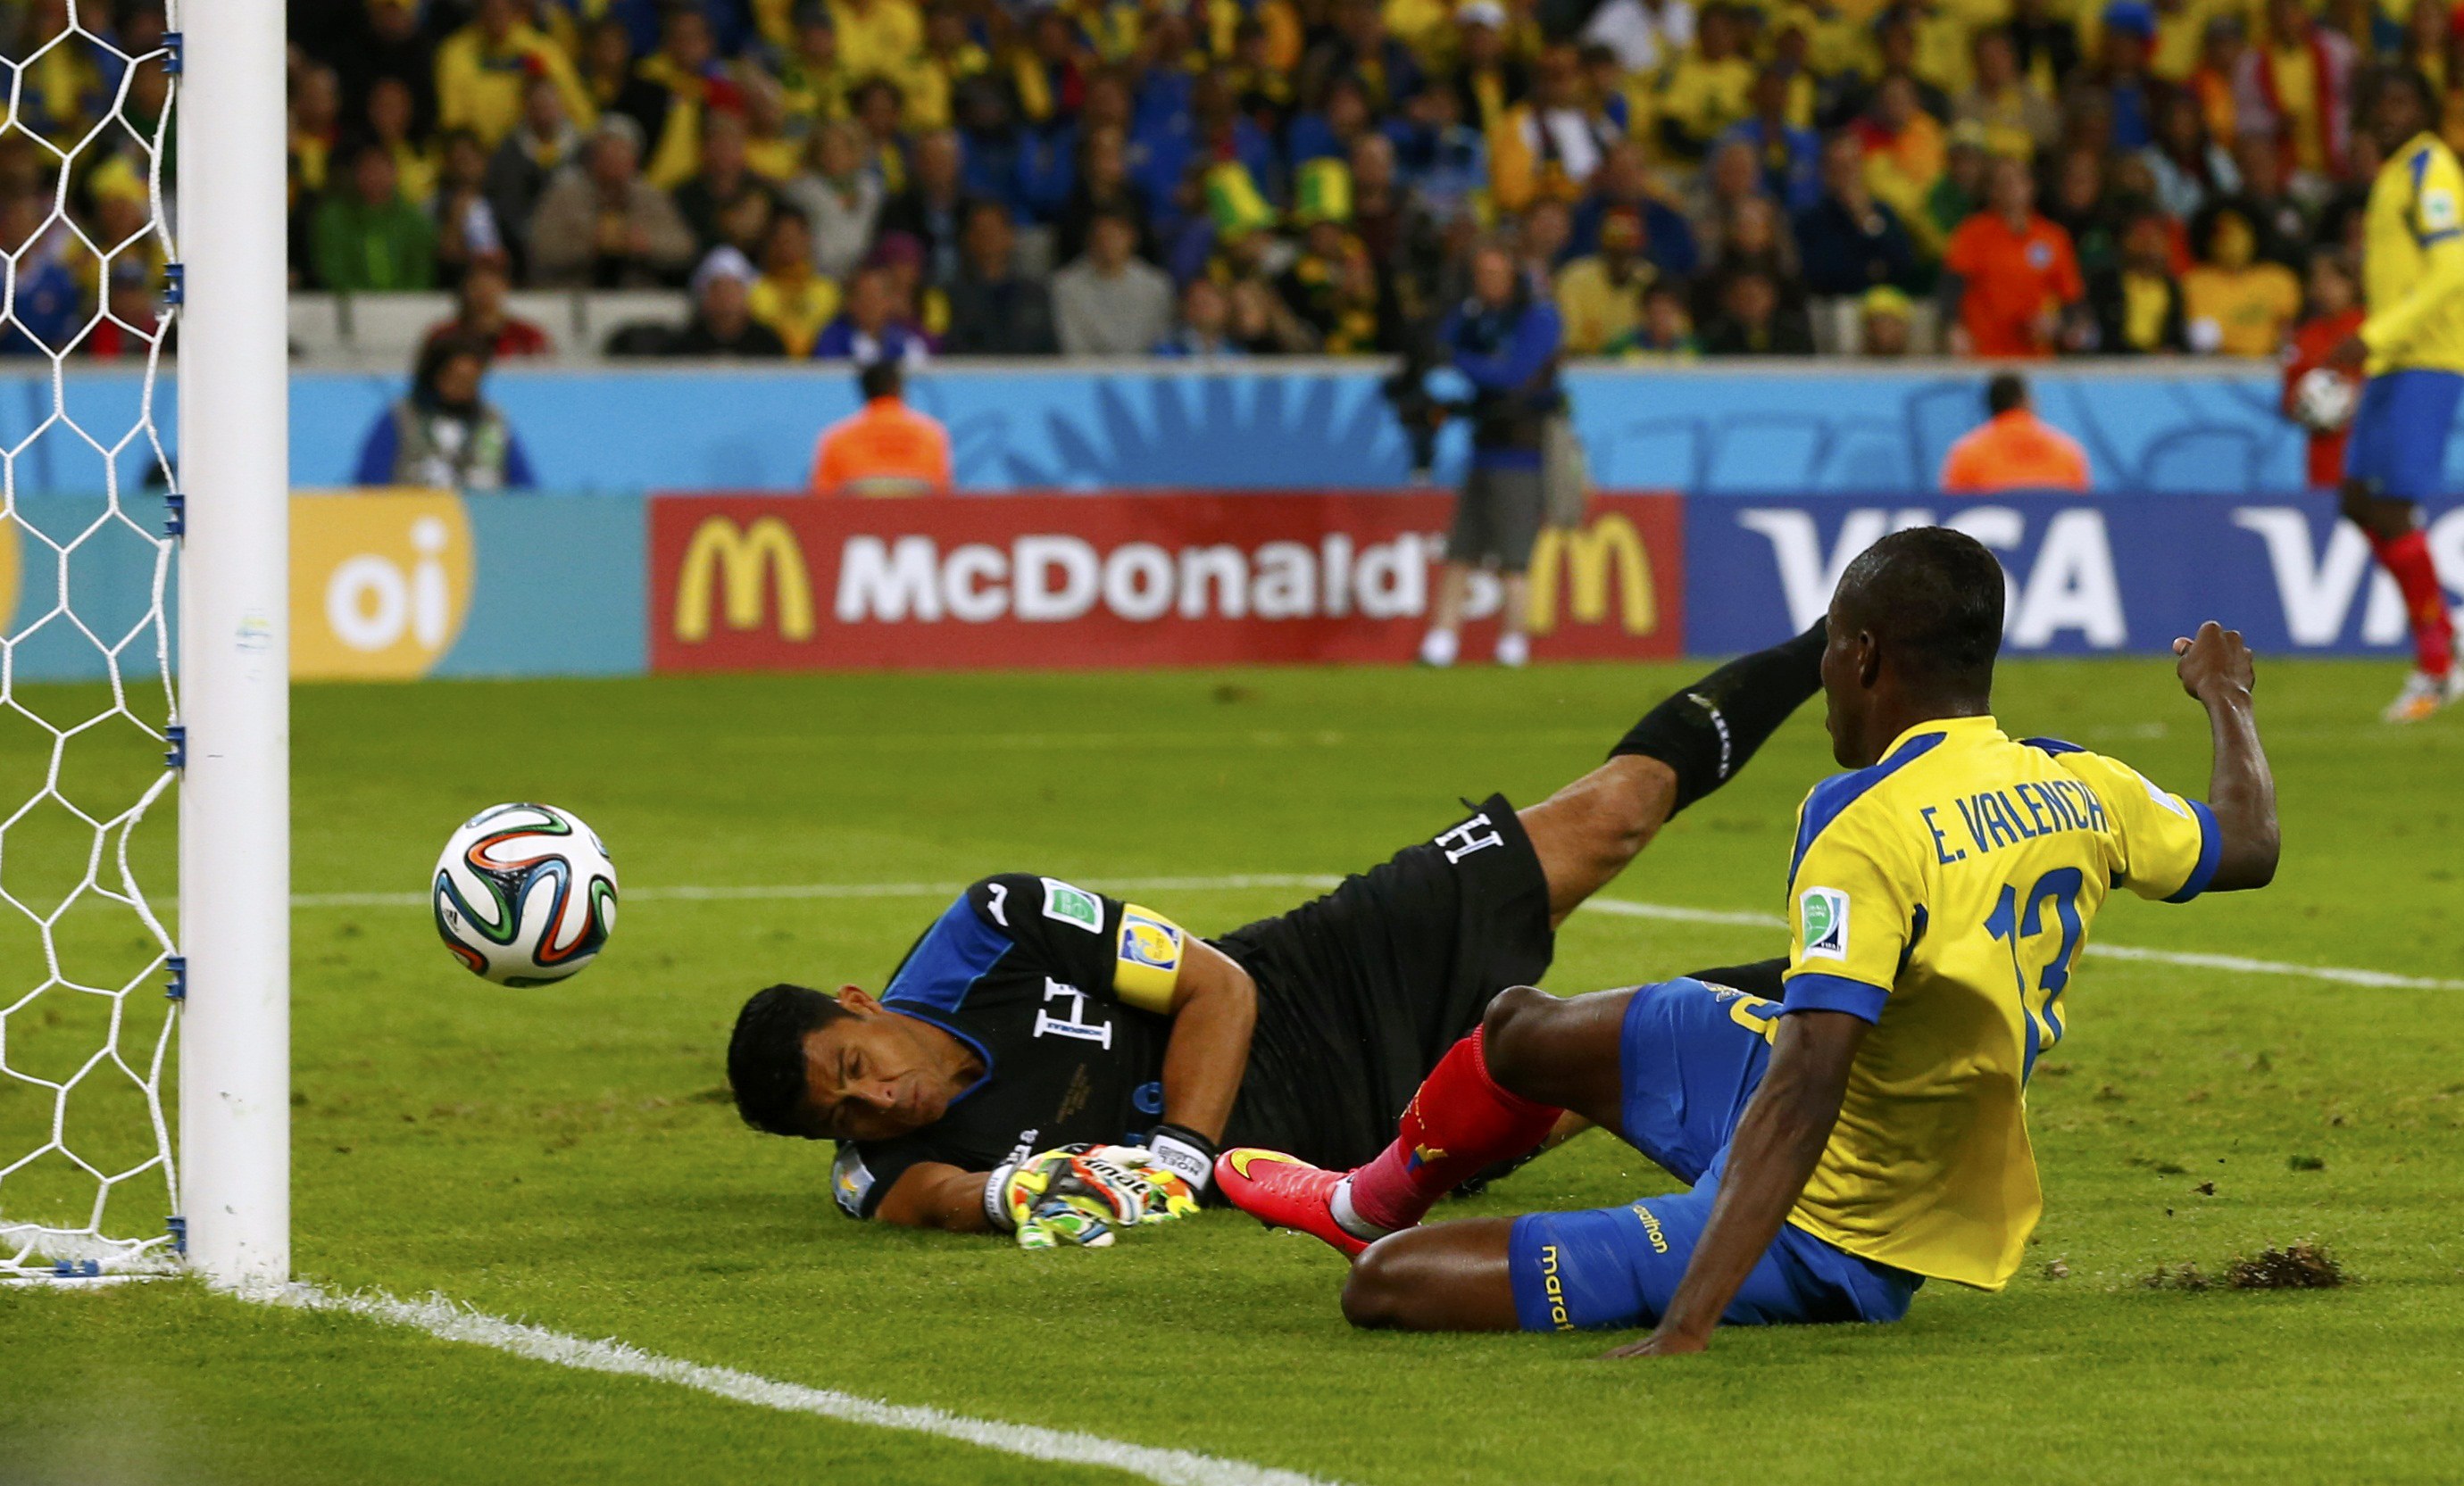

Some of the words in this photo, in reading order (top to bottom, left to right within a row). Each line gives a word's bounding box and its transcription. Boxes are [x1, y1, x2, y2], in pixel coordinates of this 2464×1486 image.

[324, 515, 448, 653] oi
[1736, 507, 2128, 648] VA
[1920, 806, 1967, 865] E.
[1983, 867, 2084, 1094] 13
